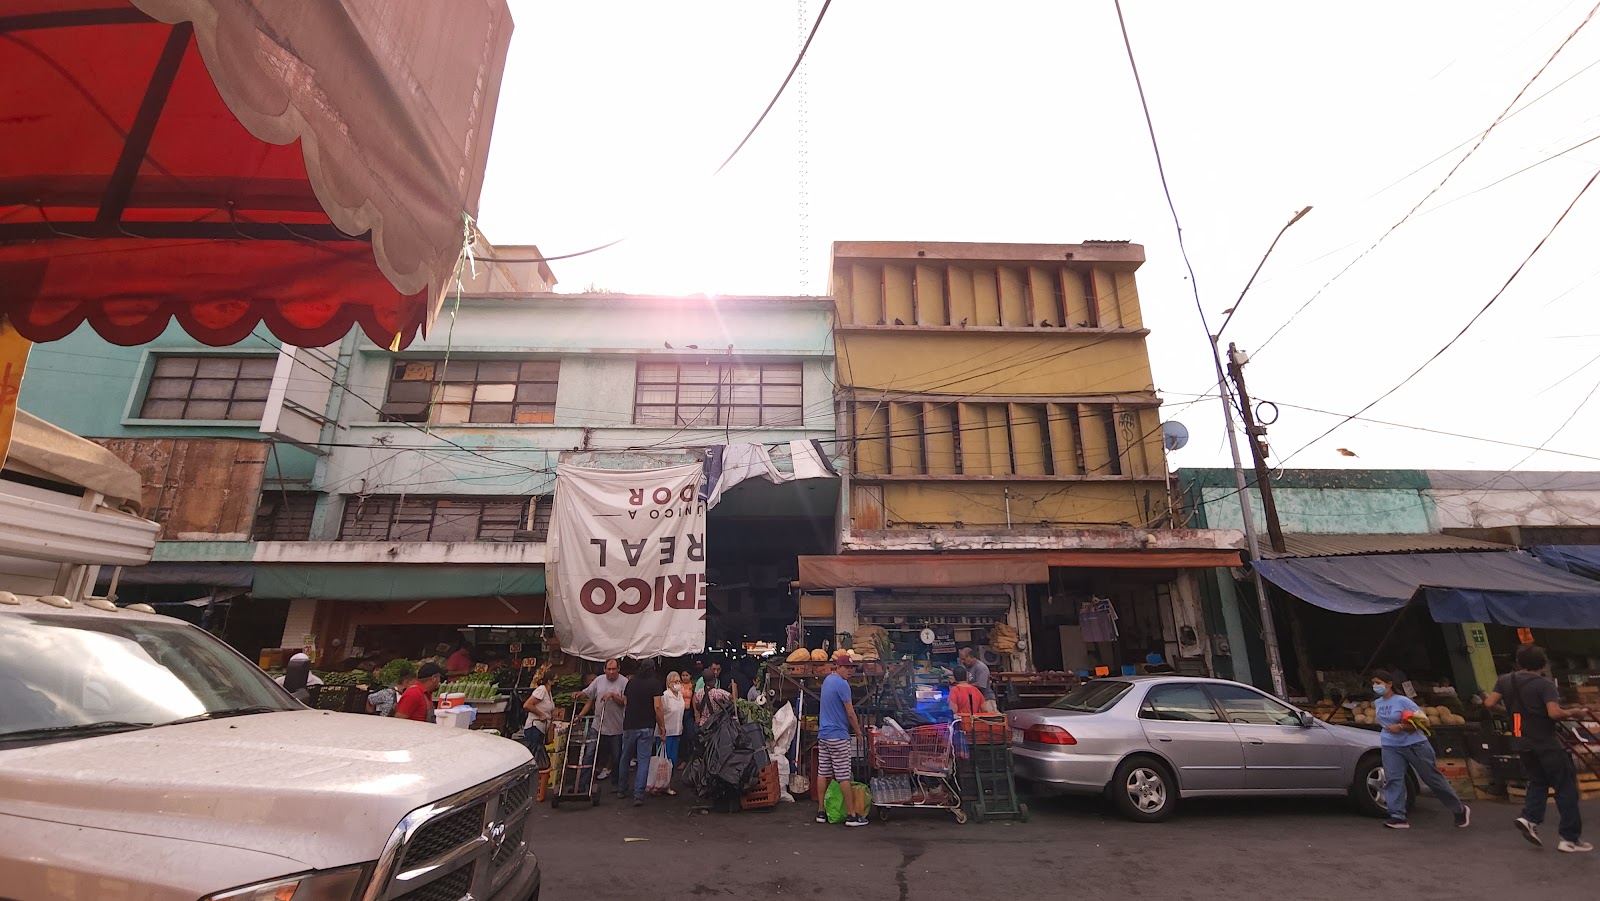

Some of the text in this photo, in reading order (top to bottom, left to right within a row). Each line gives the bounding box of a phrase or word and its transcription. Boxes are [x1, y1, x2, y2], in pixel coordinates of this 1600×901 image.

[629, 484, 695, 506] DOR
[628, 510, 637, 520] A
[590, 533, 705, 567] REAL
